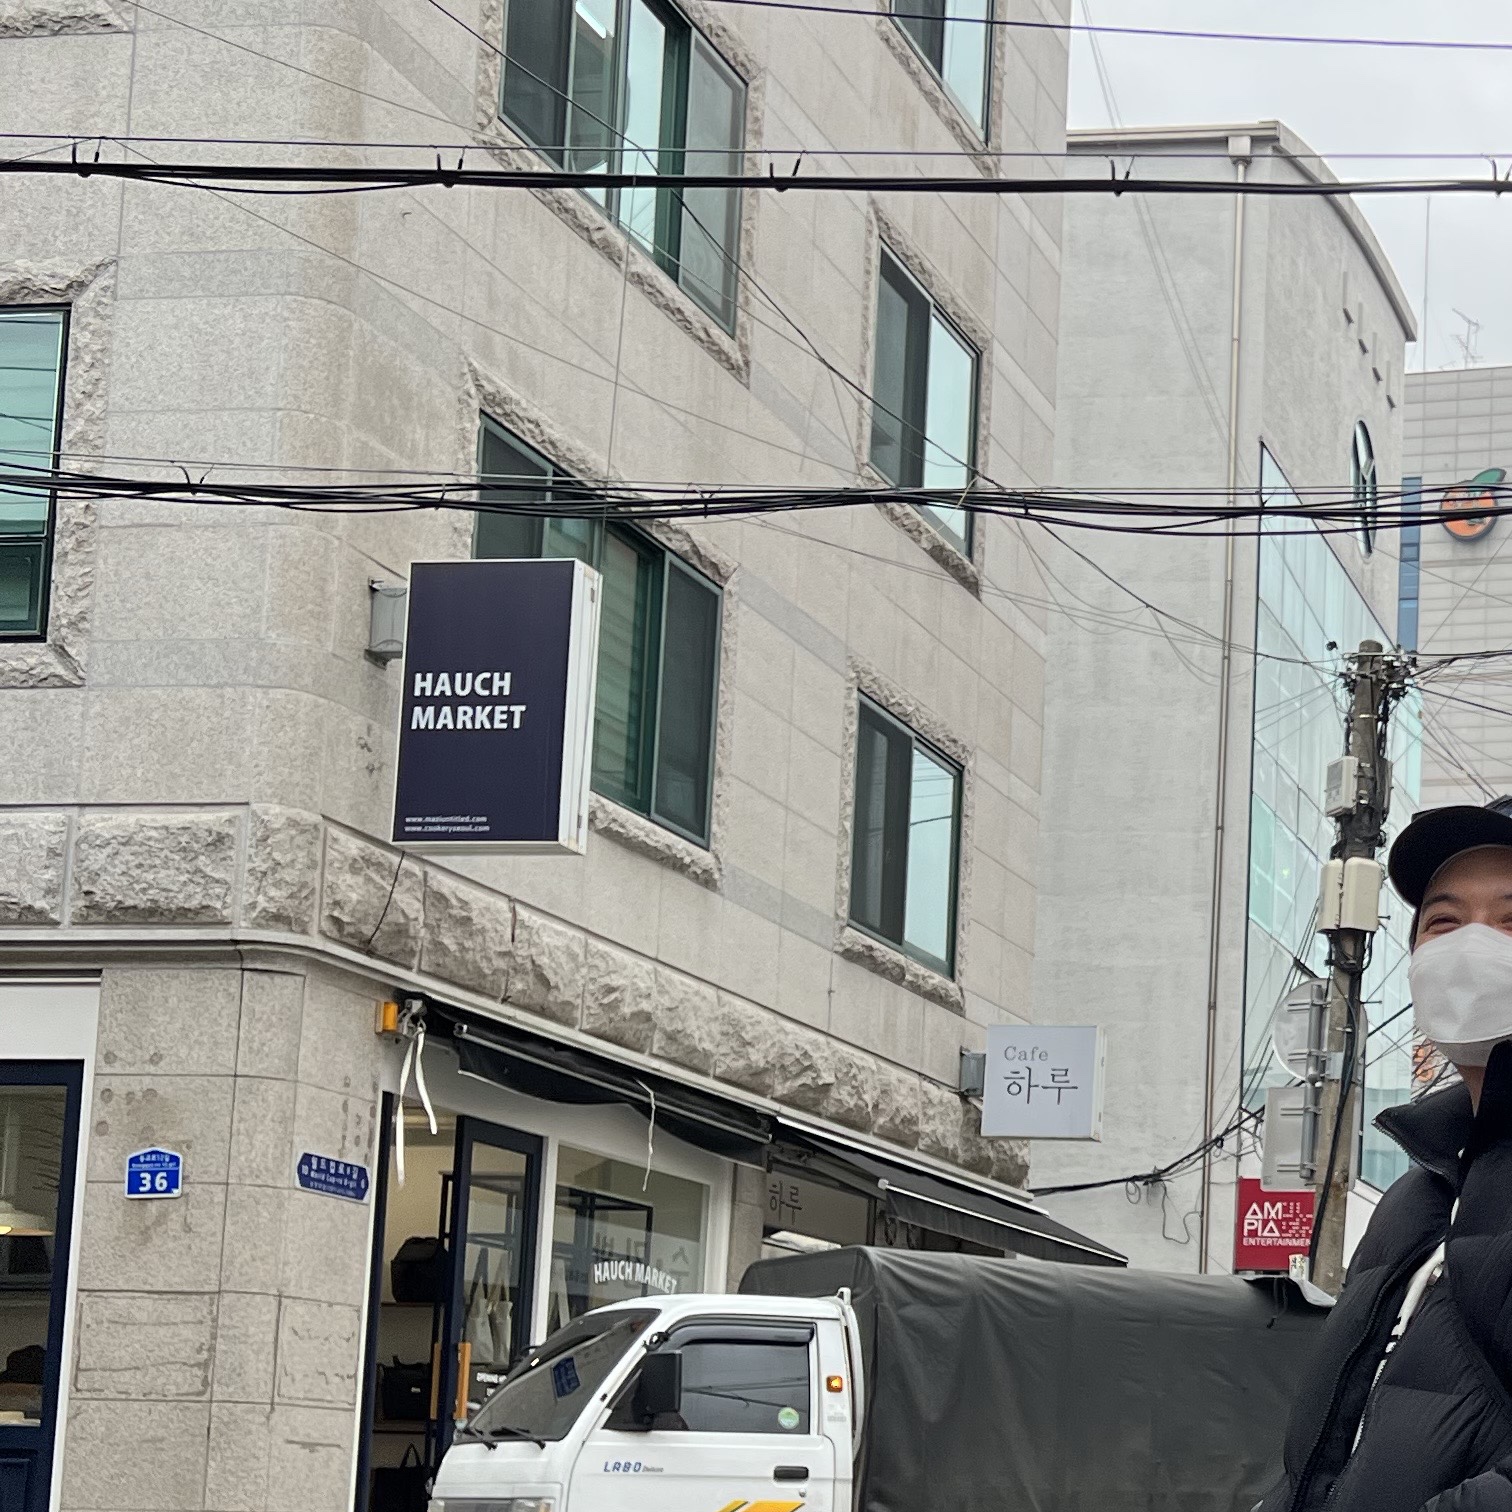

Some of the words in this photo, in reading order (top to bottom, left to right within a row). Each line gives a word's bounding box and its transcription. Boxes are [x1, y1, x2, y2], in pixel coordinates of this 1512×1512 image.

[413, 672, 512, 697] HAUCH
[411, 704, 527, 730] MARKET
[1004, 1046, 1048, 1061] Cafe
[1003, 1066, 1078, 1105] 하루
[139, 1172, 168, 1192] 36
[769, 1181, 802, 1224] 하루
[1243, 1238, 1311, 1247] ENTERTAINMEN
[594, 1260, 633, 1284] HAUCH
[635, 1263, 678, 1294] MARKET
[604, 1461, 642, 1472] LABO
